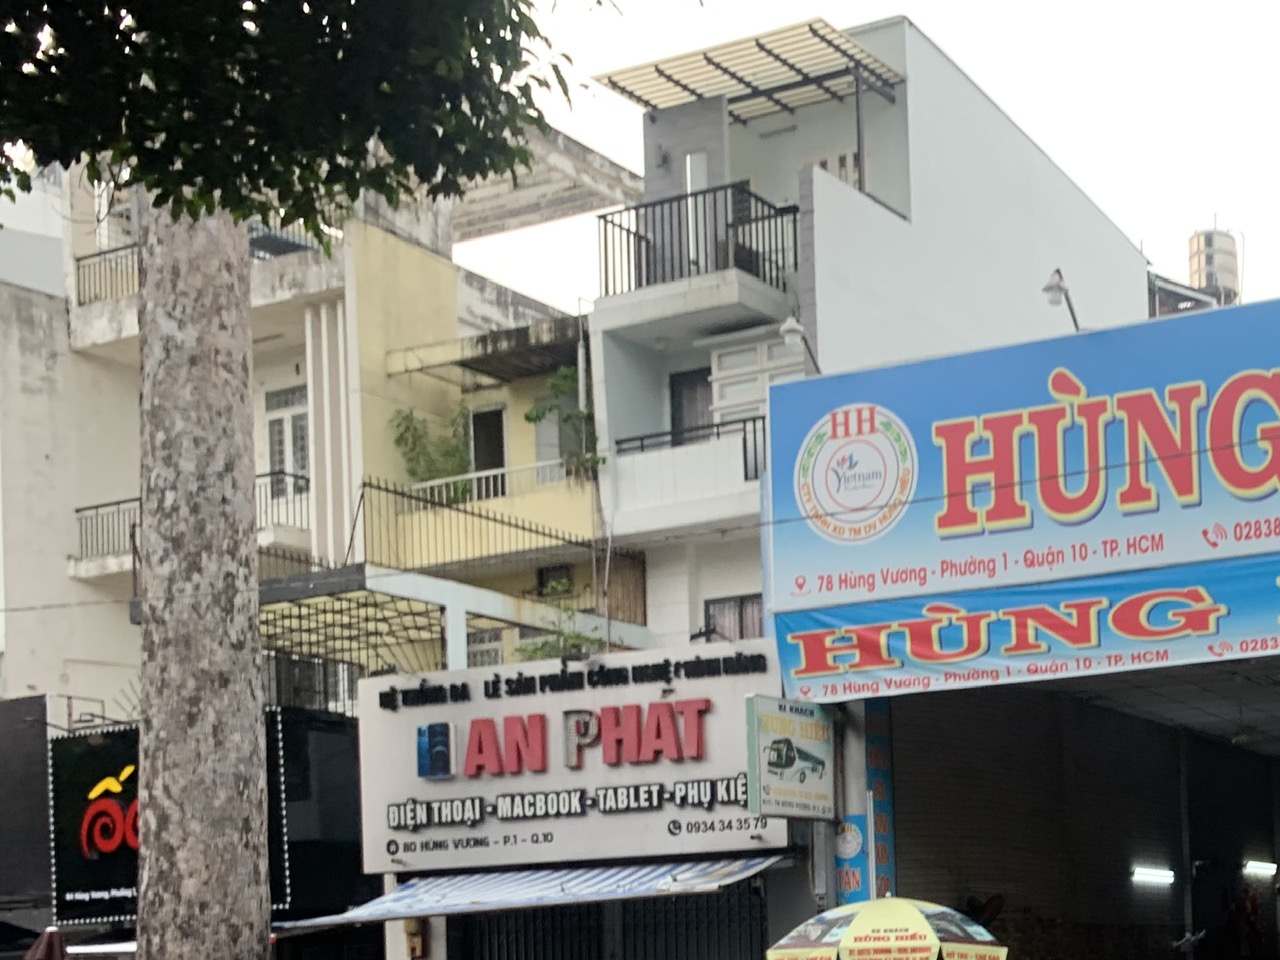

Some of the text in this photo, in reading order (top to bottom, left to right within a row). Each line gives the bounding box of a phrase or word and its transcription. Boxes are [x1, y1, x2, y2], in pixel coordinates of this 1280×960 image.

[830, 406, 877, 440] HH
[848, 526, 862, 537] TM
[817, 533, 1165, 593] 78 Hùng Vương Phường 1 Quận 10 TP. HCM
[787, 585, 1229, 680] HÙNG
[823, 682, 838, 698] 78
[842, 679, 880, 695] Hùng
[884, 675, 931, 690] Vương
[944, 666, 1000, 684] Phường
[1026, 660, 1068, 676] Quận
[1074, 656, 1092, 670] 10
[1106, 653, 1126, 667] TP.
[1131, 649, 1170, 665] HCM
[463, 713, 548, 779] AN
[388, 798, 428, 832] ĐIỆN
[431, 796, 483, 828] THOẠI
[496, 788, 586, 820] MACBOOK
[596, 783, 663, 813] TABLET
[674, 778, 712, 810] PHỤ
[717, 773, 748, 807] KIỆ
[686, 817, 768, 835] 0934 34 35 79
[420, 836, 449, 851] HÙNG
[503, 834, 518, 846] P.1
[531, 831, 554, 844] Q.10
